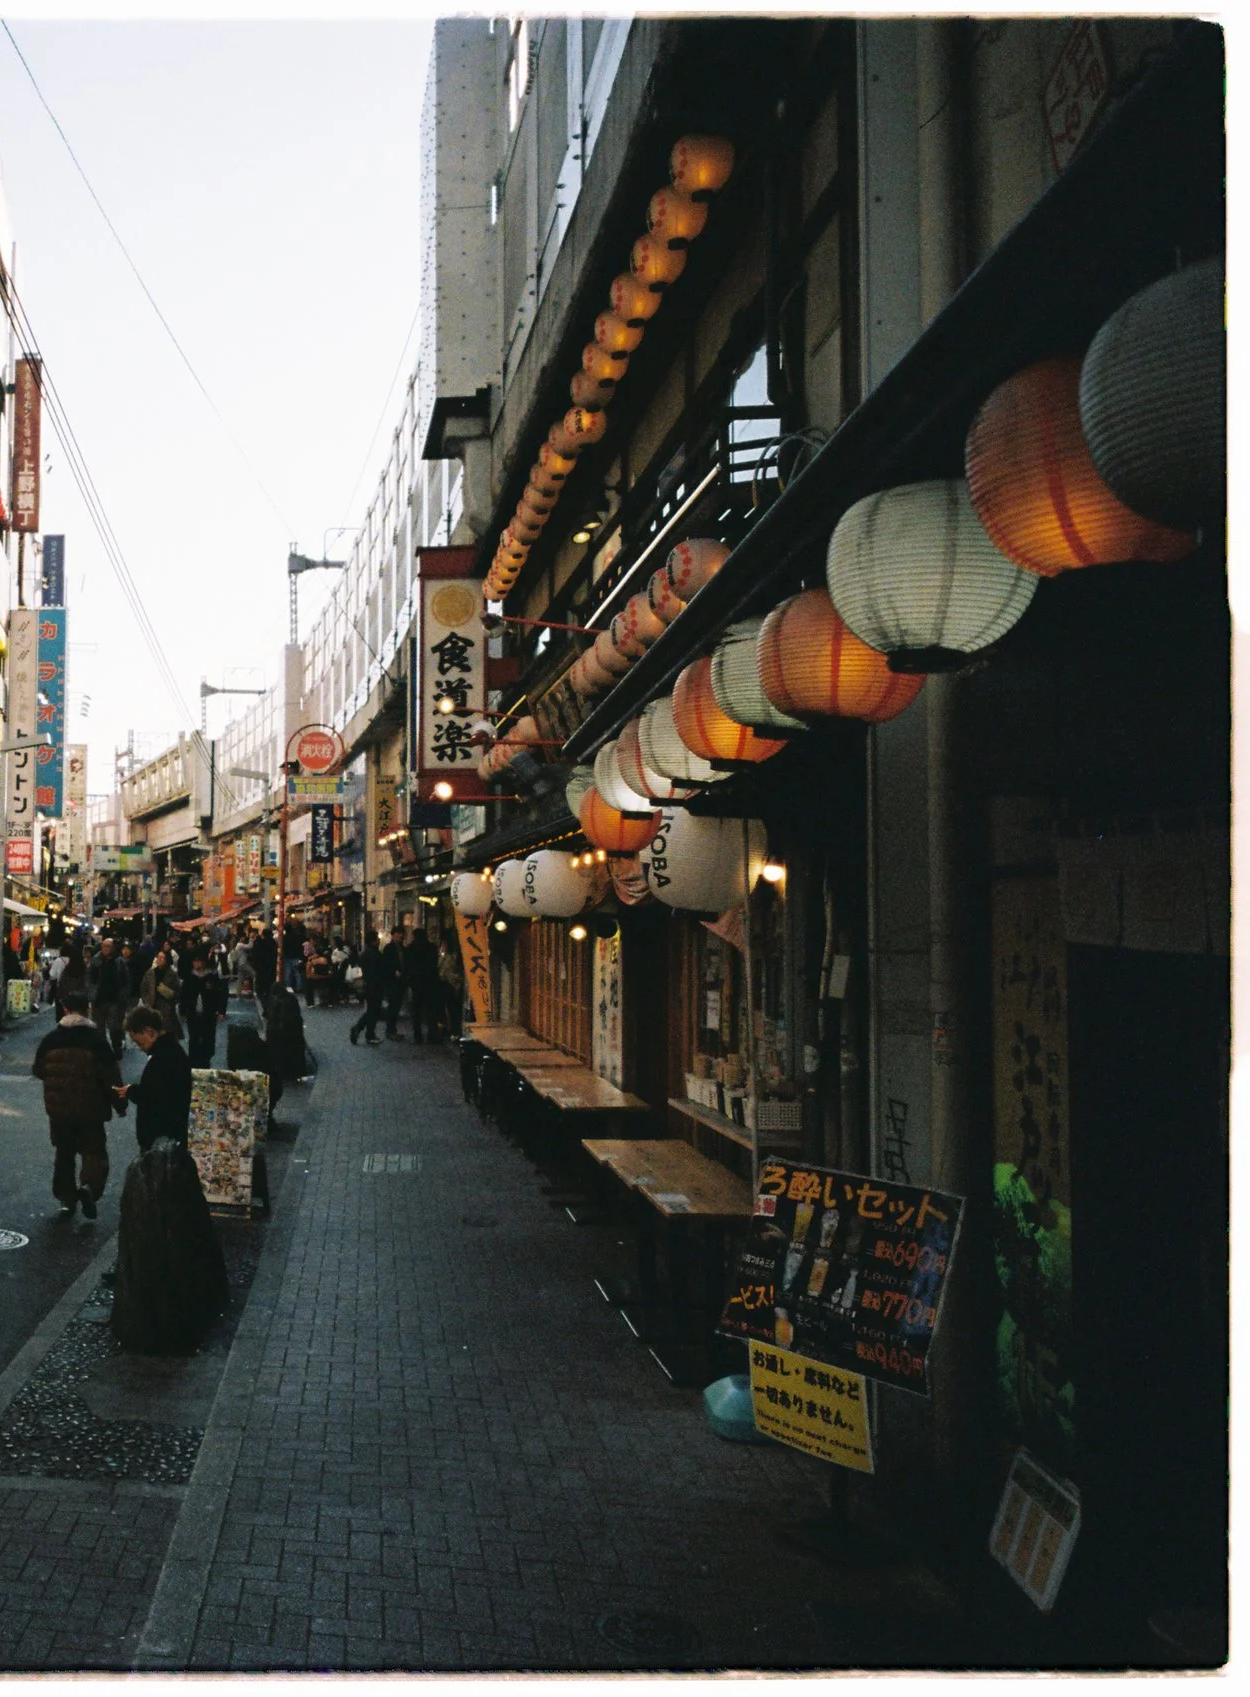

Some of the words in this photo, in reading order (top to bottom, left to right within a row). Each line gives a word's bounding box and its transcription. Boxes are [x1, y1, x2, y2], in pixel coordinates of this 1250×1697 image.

[36, 622, 57, 806] カラオケ館
[431, 632, 475, 763] 食道楽
[13, 728, 29, 815] トントン
[300, 743, 333, 758] 消火栓
[524, 859, 538, 905] ISOBA
[650, 814, 674, 889] ISOBA
[761, 1166, 949, 1229] ろ酔いセット
